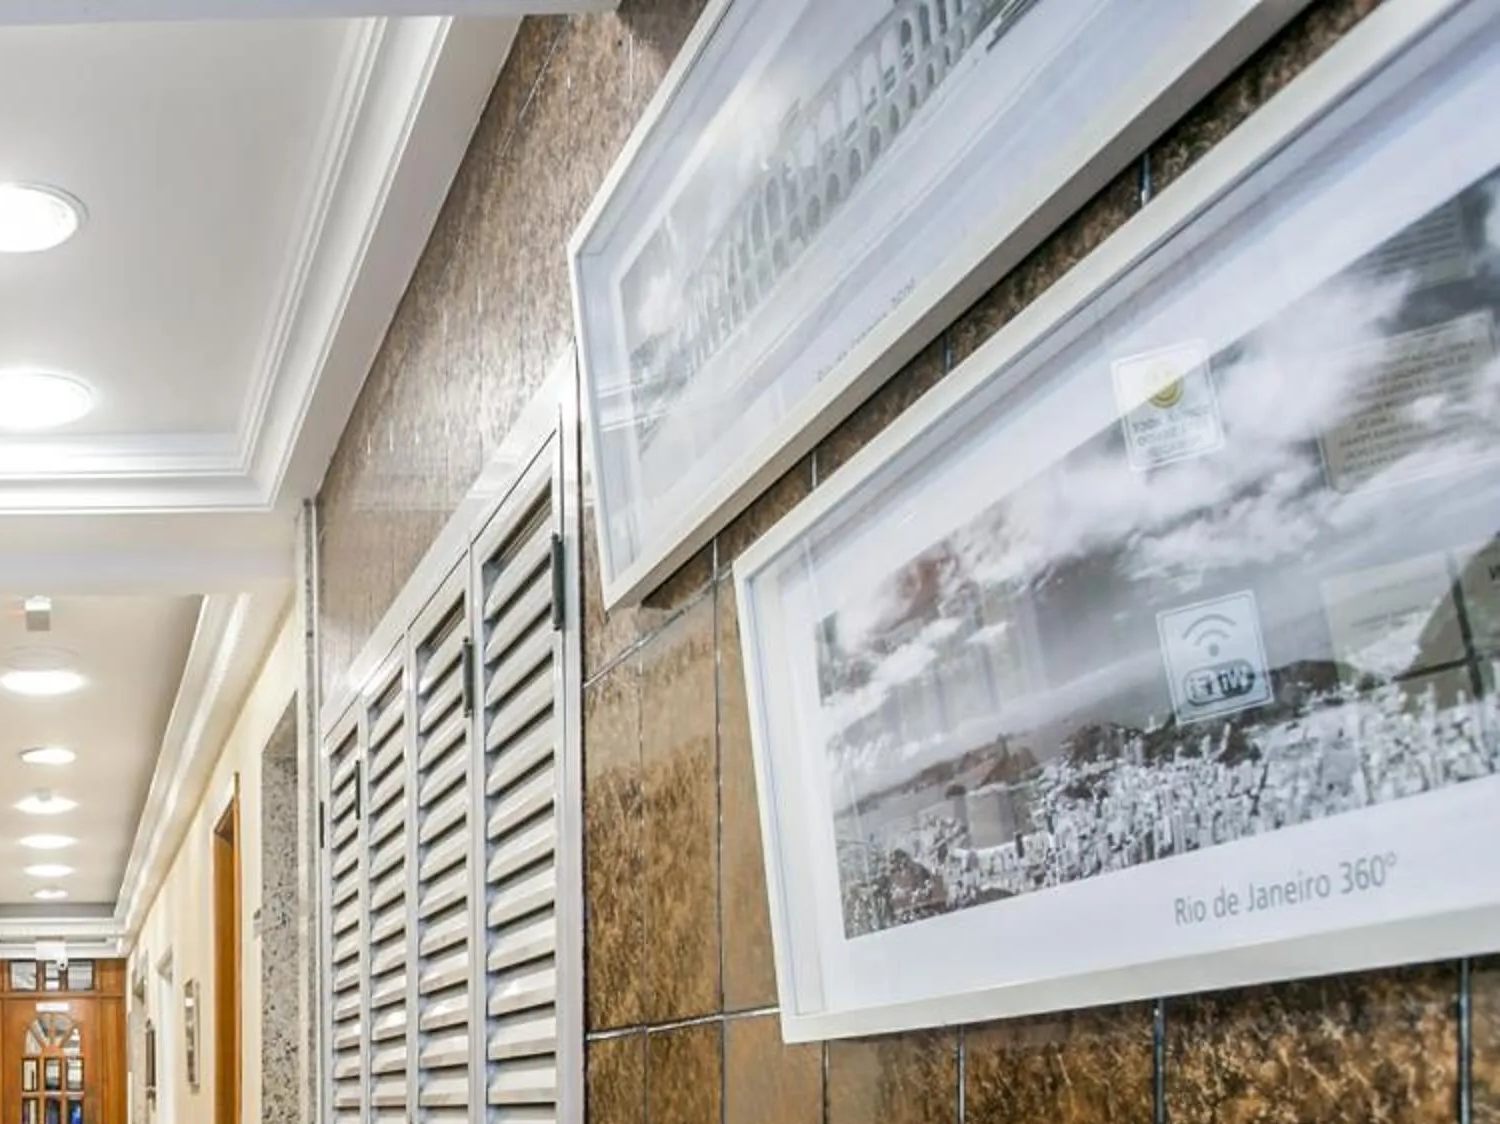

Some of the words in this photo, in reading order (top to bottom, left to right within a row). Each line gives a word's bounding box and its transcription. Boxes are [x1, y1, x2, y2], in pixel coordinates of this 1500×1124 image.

[1174, 896, 1206, 926] Rio
[1213, 883, 1239, 919] de
[1247, 868, 1331, 913] Janeiro
